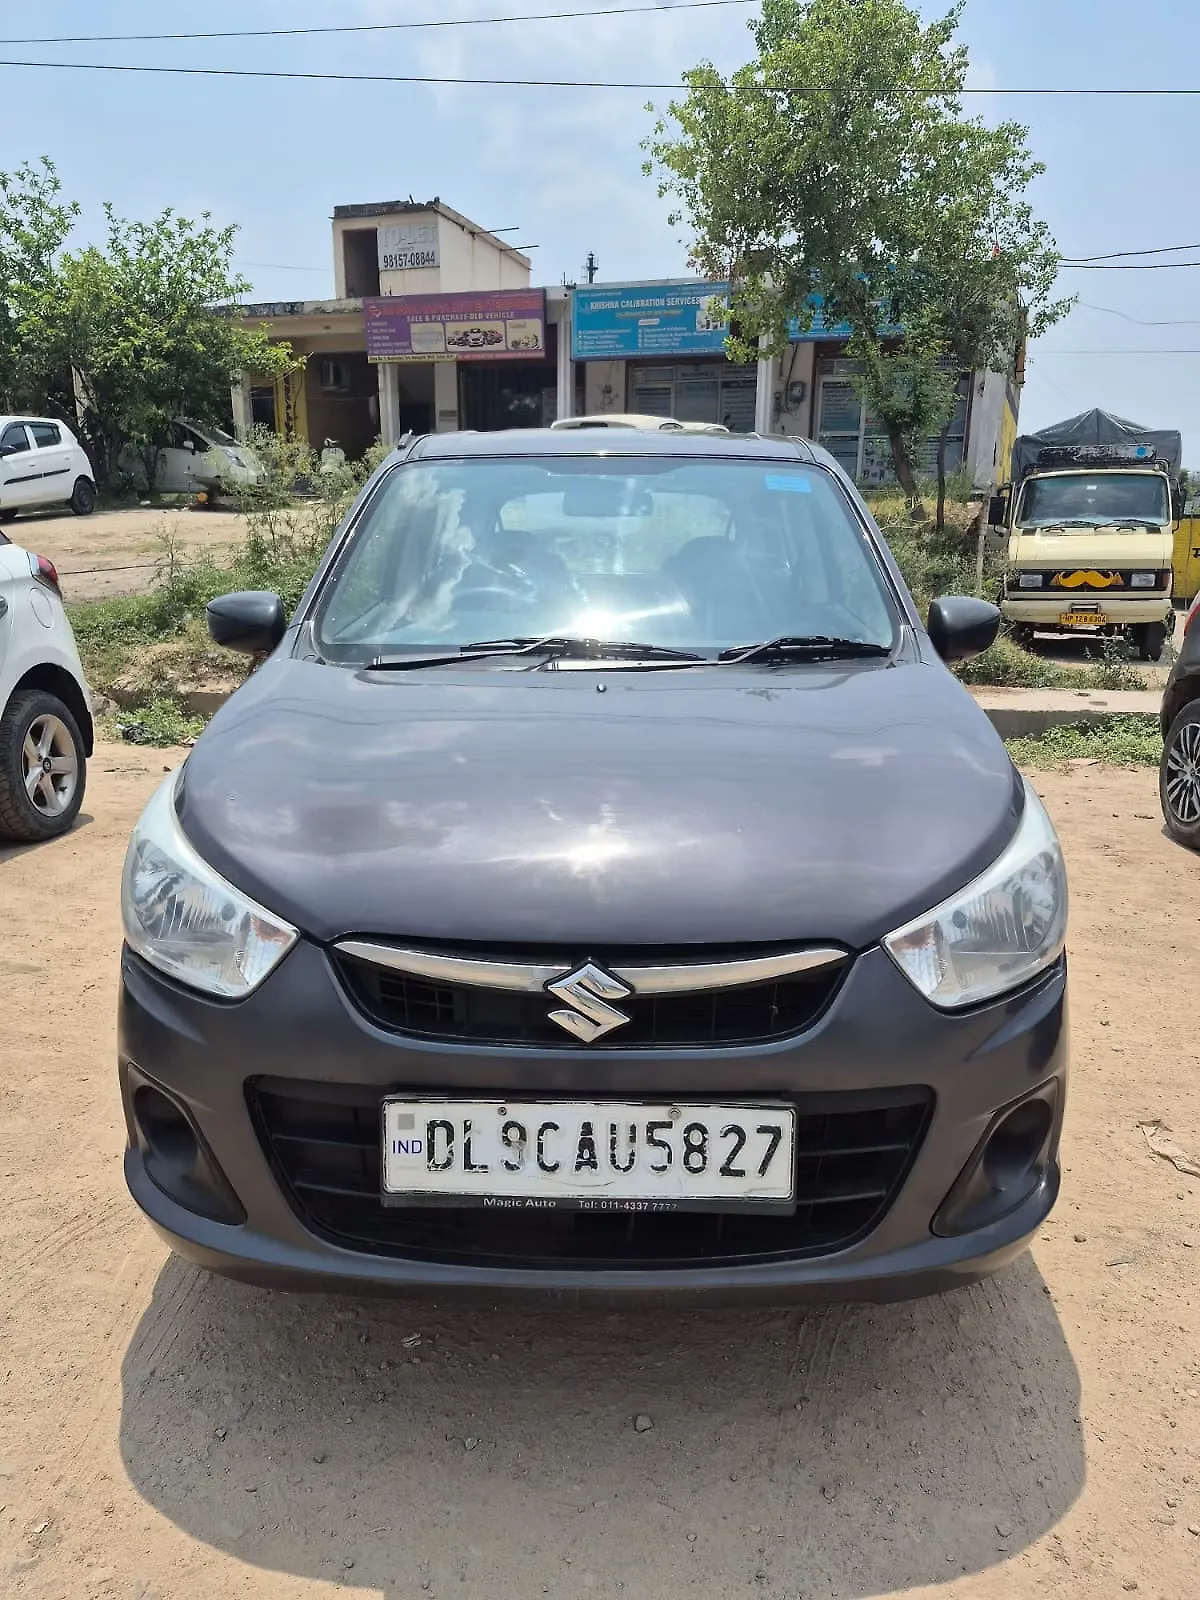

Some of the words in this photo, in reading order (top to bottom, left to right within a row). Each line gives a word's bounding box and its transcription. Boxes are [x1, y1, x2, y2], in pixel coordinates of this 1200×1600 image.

[383, 250, 435, 268] 98157-08844
[621, 298, 665, 309] CALIBRATION
[666, 297, 701, 306] SERVICES
[485, 311, 515, 319] VEHICLE
[393, 1140, 423, 1154] IND
[483, 1198, 522, 1208] Magic
[525, 1199, 557, 1208] Auto
[600, 1201, 649, 1210] 011-4337
